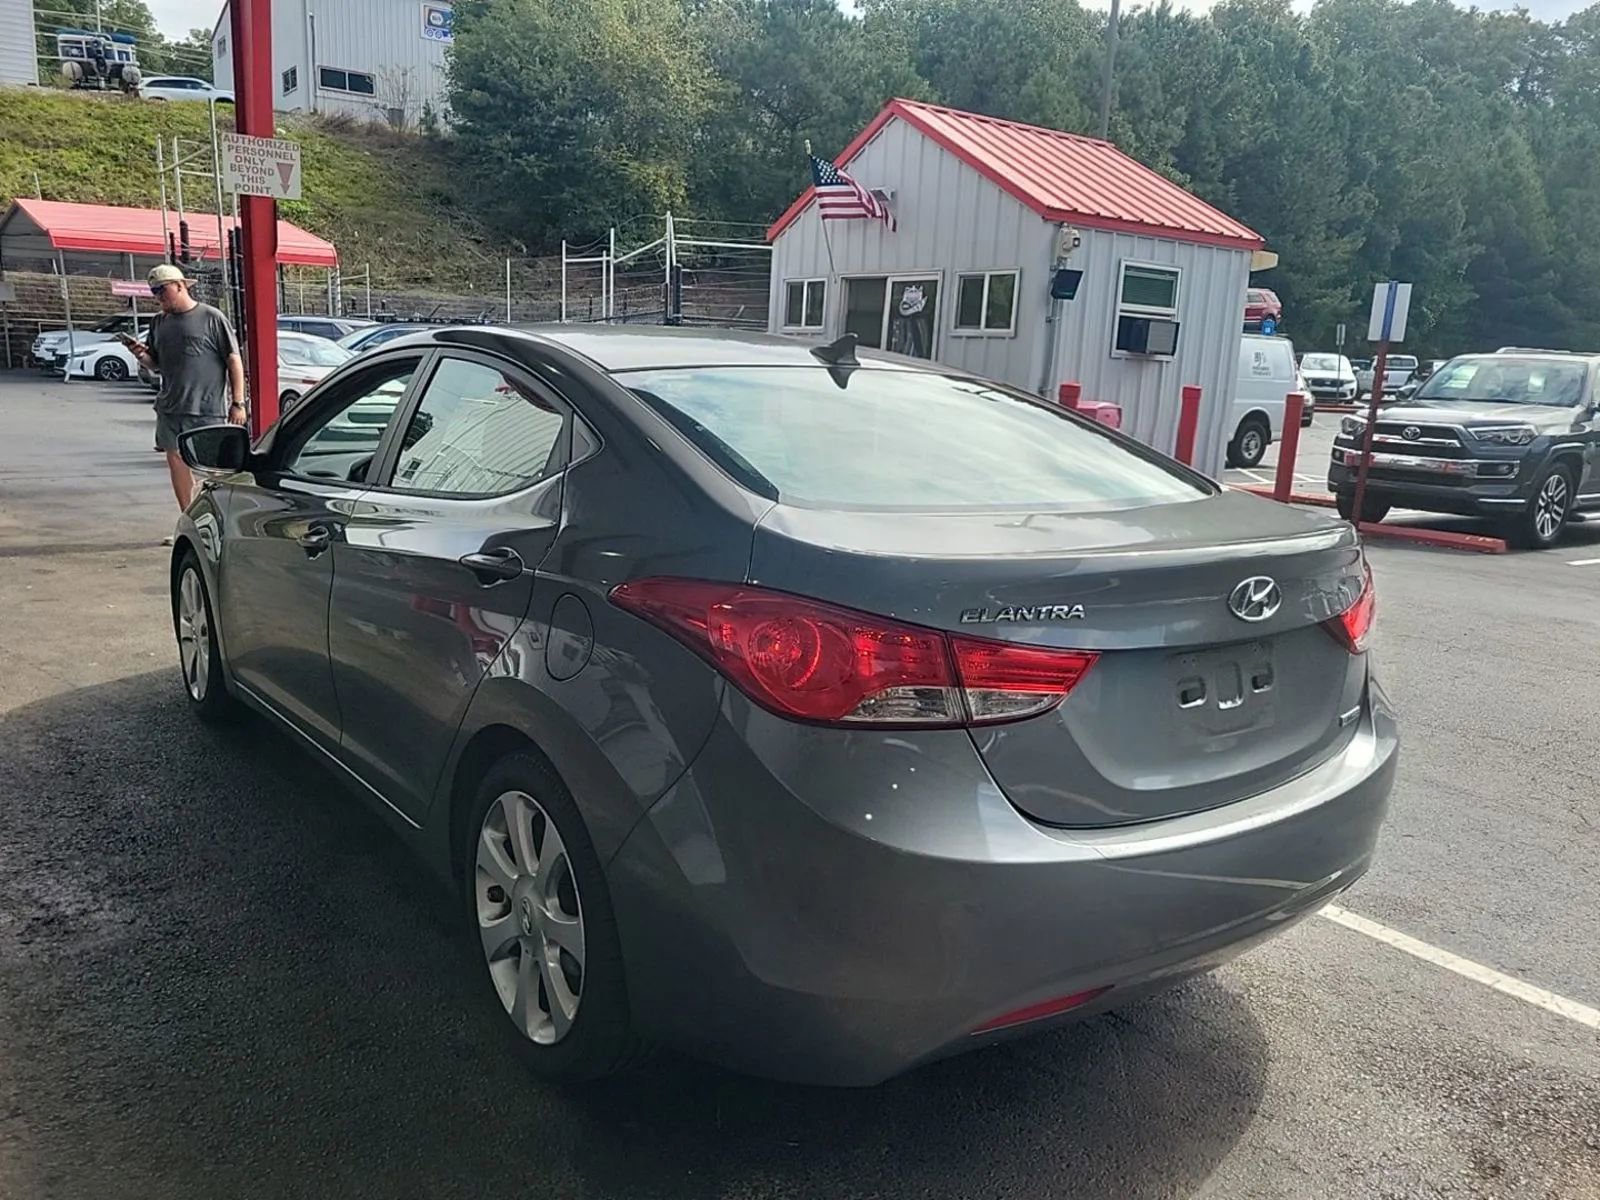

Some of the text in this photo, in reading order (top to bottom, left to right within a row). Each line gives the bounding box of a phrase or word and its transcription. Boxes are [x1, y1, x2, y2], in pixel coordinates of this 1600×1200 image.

[223, 134, 300, 152] AUTHORIZED
[228, 144, 296, 161] PERSONNEL
[235, 155, 266, 166] ONLY
[230, 163, 274, 176] BEYOND
[240, 174, 266, 185] THIS
[960, 604, 1086, 624] ELANTRA
